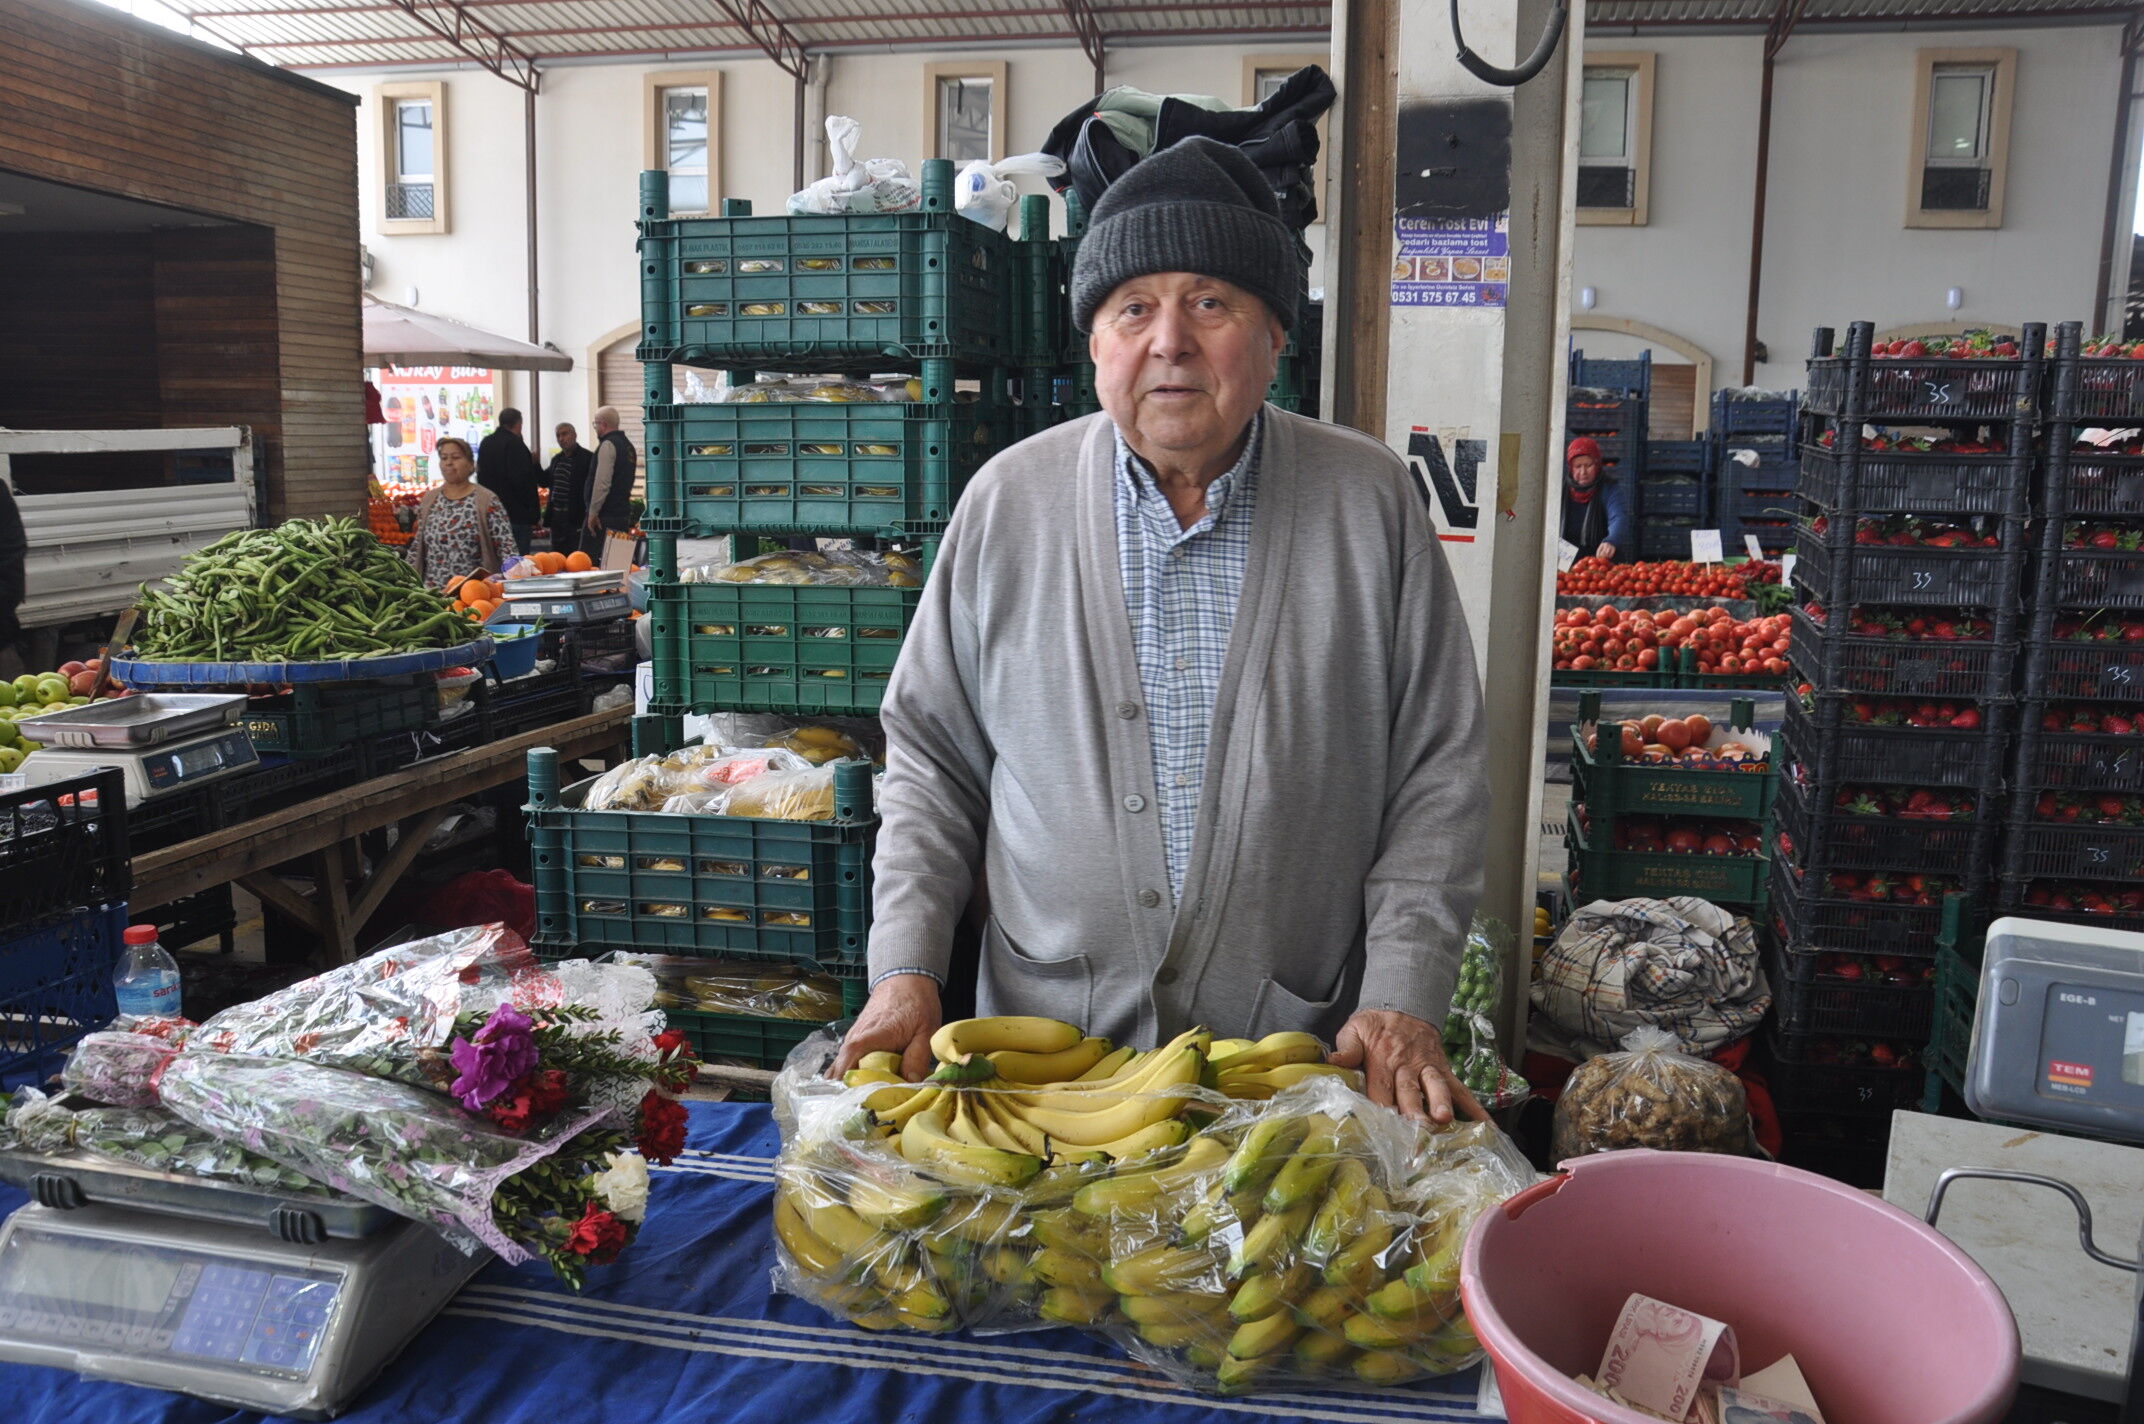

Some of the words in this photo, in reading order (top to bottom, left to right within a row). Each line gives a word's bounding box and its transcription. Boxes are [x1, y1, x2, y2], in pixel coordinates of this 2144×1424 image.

[1432, 238, 1468, 246] bazlama
[1471, 238, 1488, 247] tost
[1392, 291, 1418, 303] 0531
[1422, 291, 1443, 303] 575
[1445, 291, 1459, 303] 67
[1461, 292, 1476, 303] 45
[1924, 381, 1950, 404] 35
[1912, 572, 1932, 589] 35
[2107, 666, 2131, 684] 35
[2059, 992, 2096, 1006] EGE-B
[2054, 1062, 2091, 1076] TEM
[1604, 1343, 1629, 1388] 200
[1669, 1384, 1689, 1414] 200
